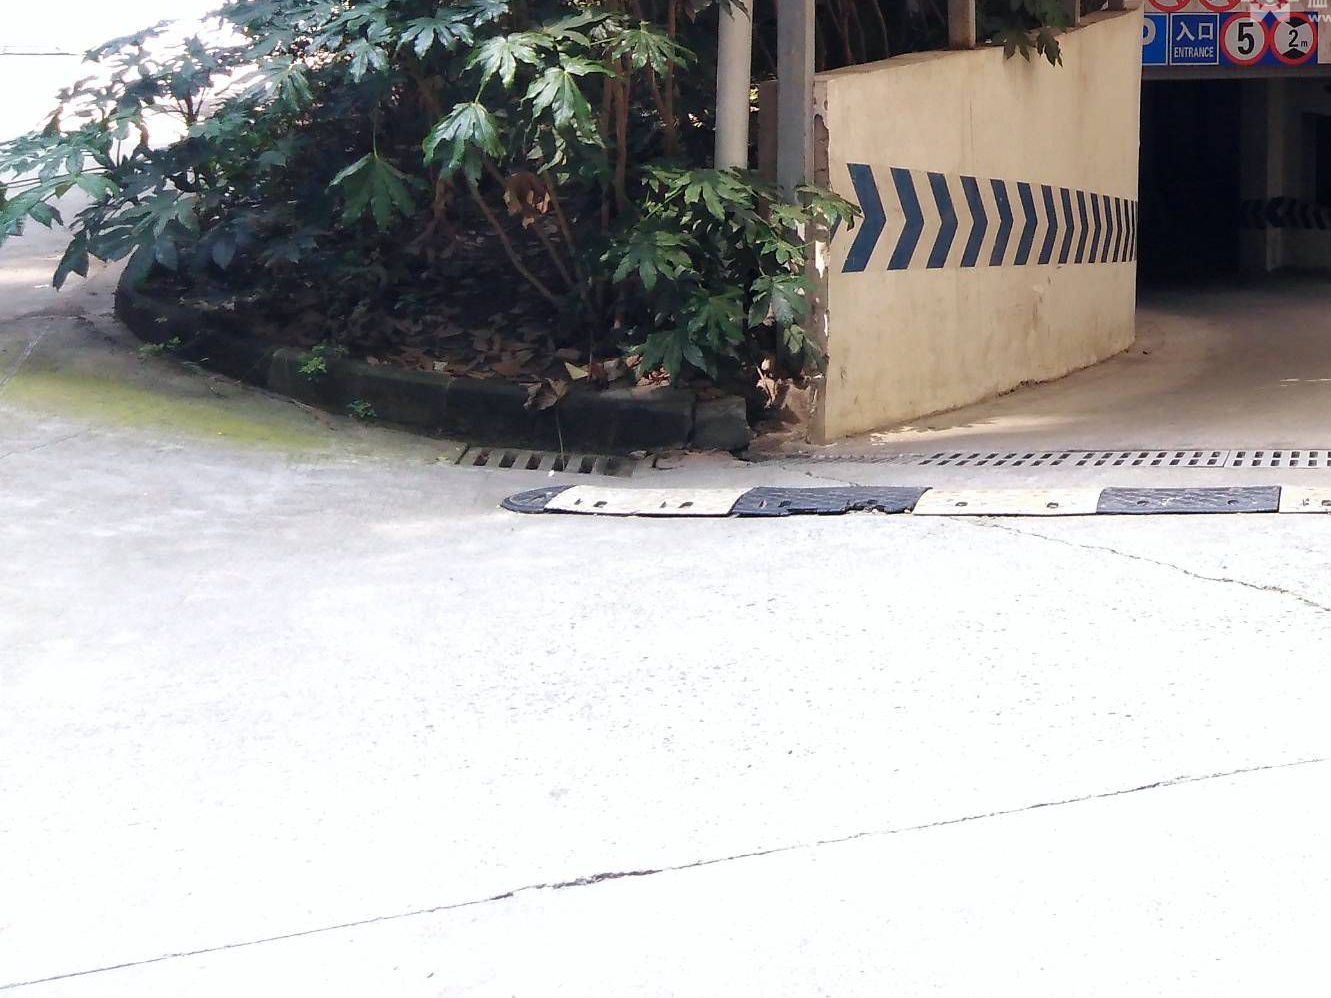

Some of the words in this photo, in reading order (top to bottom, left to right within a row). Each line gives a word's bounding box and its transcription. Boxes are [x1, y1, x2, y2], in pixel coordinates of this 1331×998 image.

[1176, 21, 1214, 41] 入口
[1237, 21, 1255, 55] 5
[1174, 47, 1214, 58] ENTRANCE
